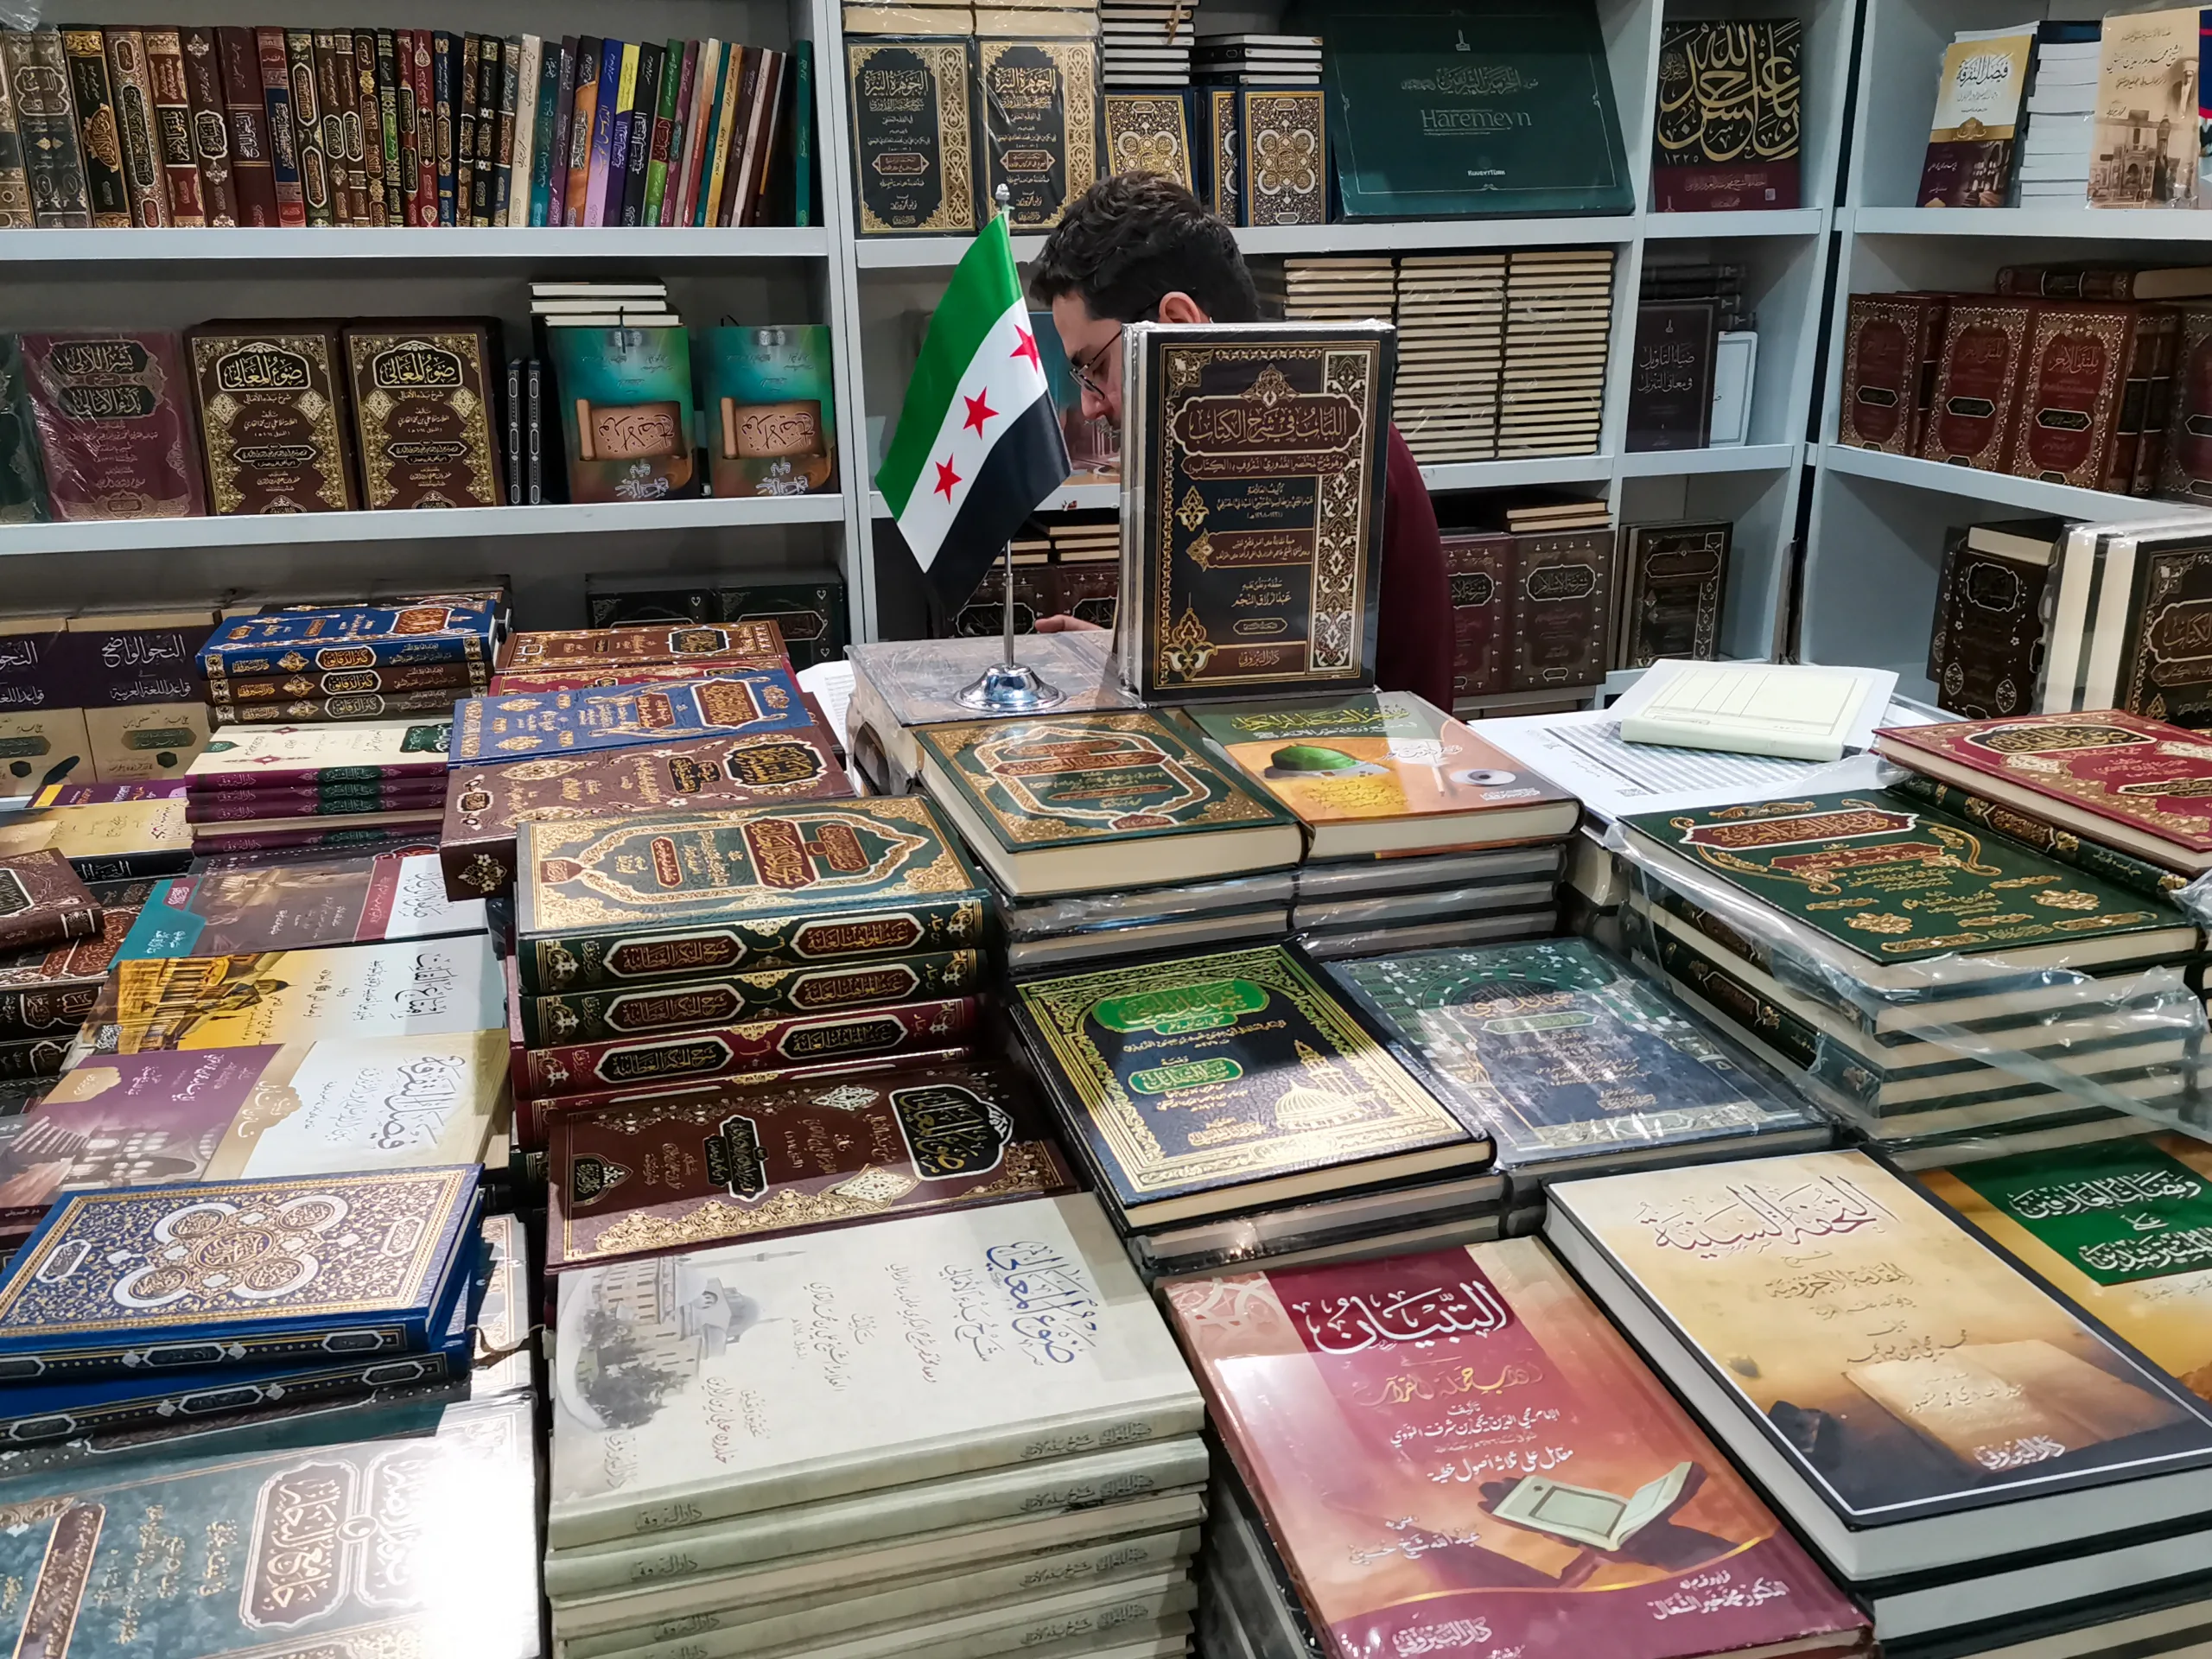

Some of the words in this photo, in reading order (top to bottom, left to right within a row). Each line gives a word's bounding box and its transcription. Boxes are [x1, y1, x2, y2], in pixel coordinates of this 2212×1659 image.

[864, 70, 889, 97] النيرة
[888, 69, 929, 97] الجوهرة
[1018, 67, 1056, 93] الجوهرة
[1421, 109, 1533, 129] Haremeyn
[378, 352, 426, 387] المعالي
[1639, 345, 1675, 371] التأويل
[1673, 344, 1694, 368] ضياء
[224, 353, 273, 388] المعالي
[1188, 408, 1248, 445] الكتاب
[1295, 405, 1348, 442] اللباب
[101, 635, 144, 669] الواضح
[143, 633, 187, 664] النحو
[323, 651, 357, 668] الدقائق
[109, 681, 144, 702] العربية
[328, 675, 361, 692] الدقائق
[333, 698, 365, 716] الدقائق
[806, 927, 844, 951] العلية
[621, 944, 671, 971] العطائية
[804, 978, 842, 1004] العلية
[621, 1000, 671, 1026] العطائية
[792, 1032, 830, 1054] العلية
[612, 1052, 662, 1079] العطائية
[1640, 1184, 1799, 1260] السنية
[1292, 1279, 1508, 1355] التبيان
[1973, 1434, 2049, 1471] البيروتي
[1392, 1620, 1468, 1657] البيروتي
